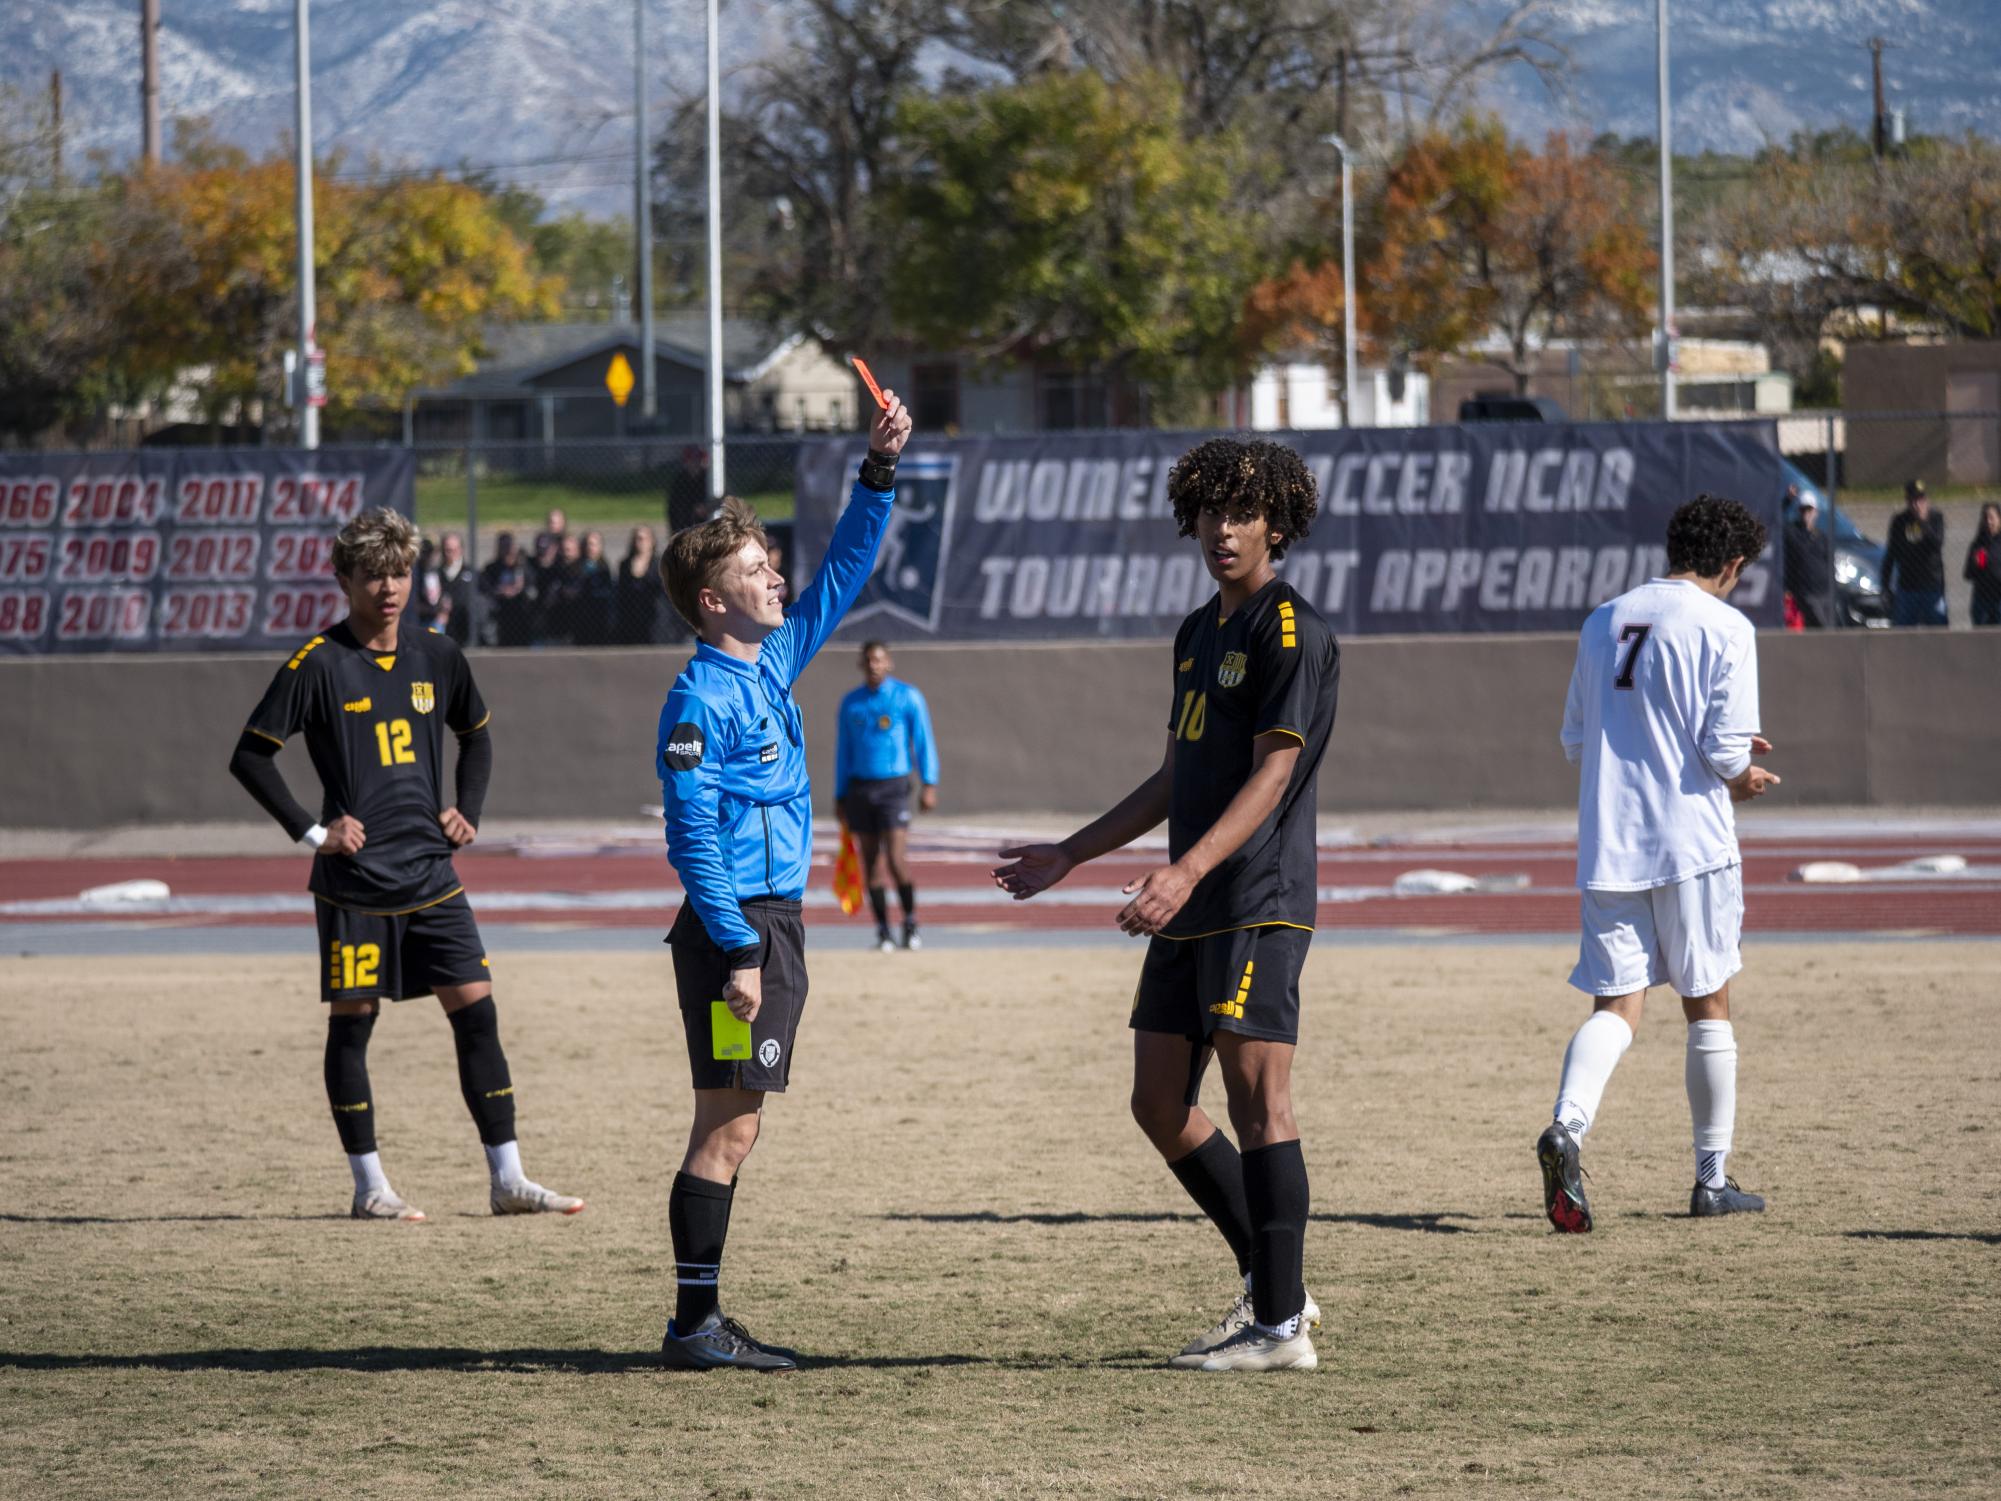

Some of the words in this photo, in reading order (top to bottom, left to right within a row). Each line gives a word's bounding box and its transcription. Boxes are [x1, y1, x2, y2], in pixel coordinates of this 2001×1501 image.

[63, 476, 166, 527] 2004
[175, 474, 263, 524] 2011
[266, 473, 363, 523] 2014
[1484, 448, 1635, 512] NCAA
[57, 531, 160, 582] 2009
[164, 531, 260, 581] 2012
[266, 531, 336, 581] 202
[980, 552, 1359, 618] TOURNANT
[57, 590, 151, 638] 2010
[159, 587, 256, 638] 2013
[263, 586, 348, 636] 202
[1614, 623, 1653, 690] 7
[1176, 690, 1206, 741] 10
[375, 719, 416, 767] 12
[665, 740, 702, 754] apelli
[342, 943, 381, 988] 12
